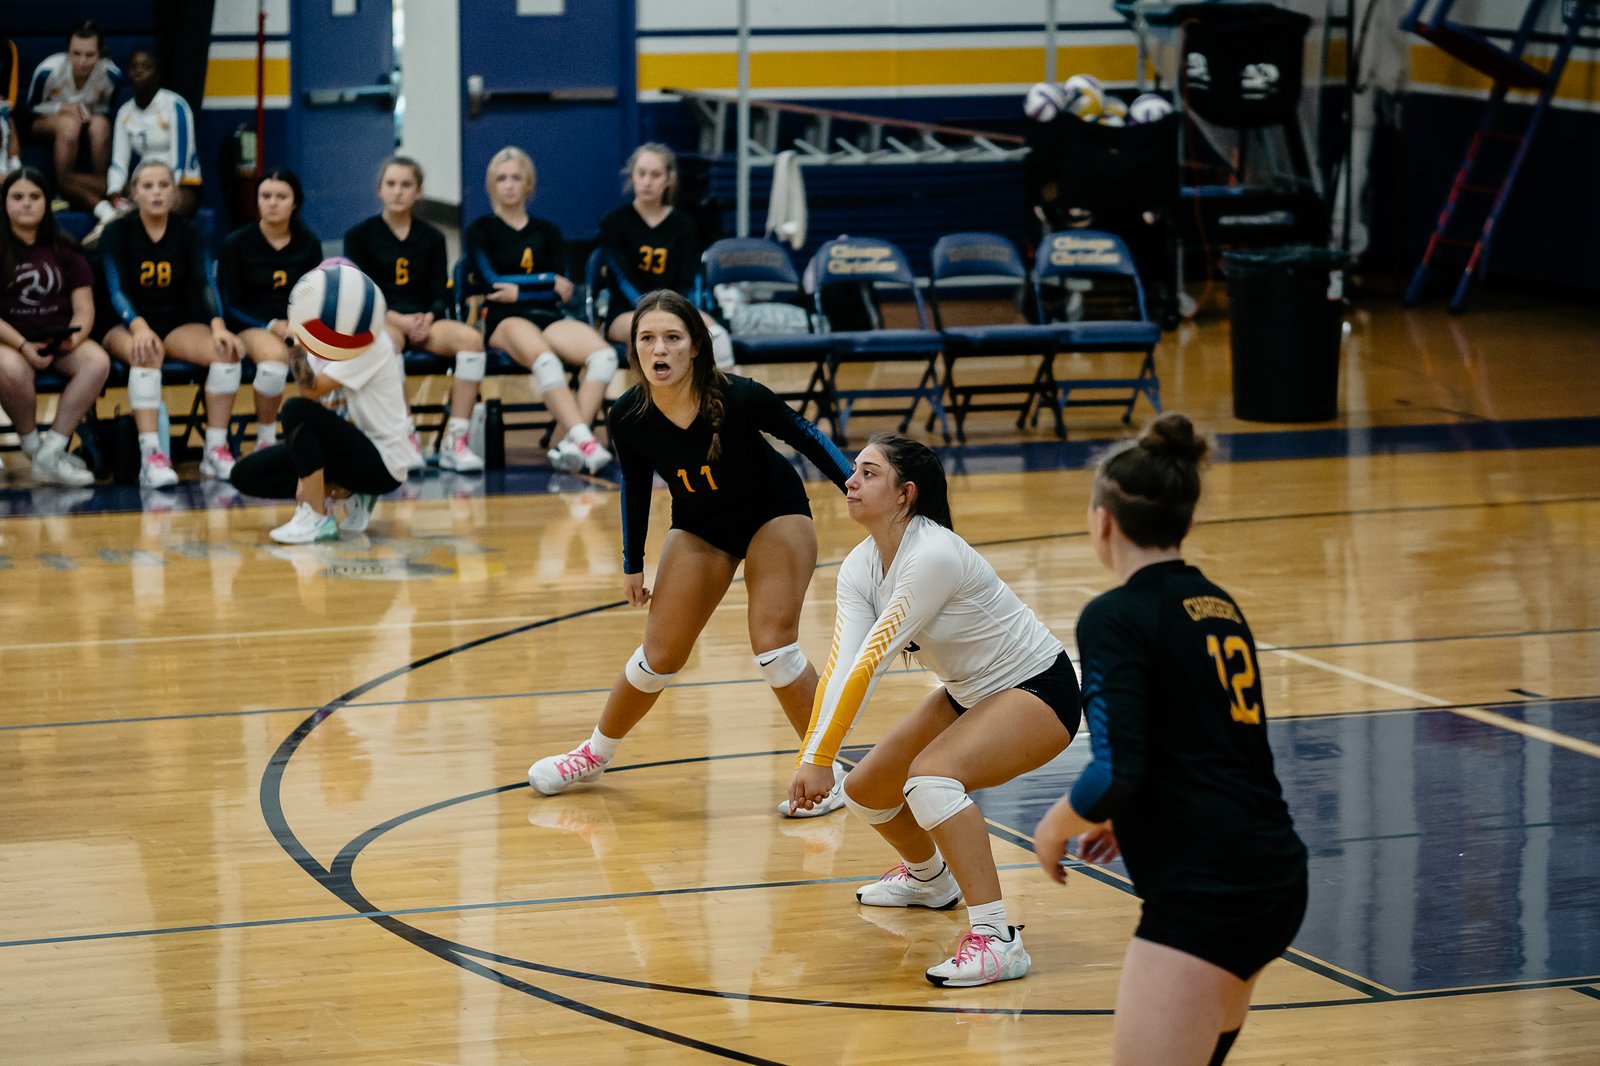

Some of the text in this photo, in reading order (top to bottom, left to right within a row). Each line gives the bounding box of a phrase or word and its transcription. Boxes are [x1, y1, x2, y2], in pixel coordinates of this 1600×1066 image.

[139, 260, 172, 287] 28
[395, 257, 410, 285] 6
[520, 246, 533, 274] 4
[638, 245, 668, 274] 33
[677, 465, 718, 492] 11
[1206, 634, 1261, 725] 12
